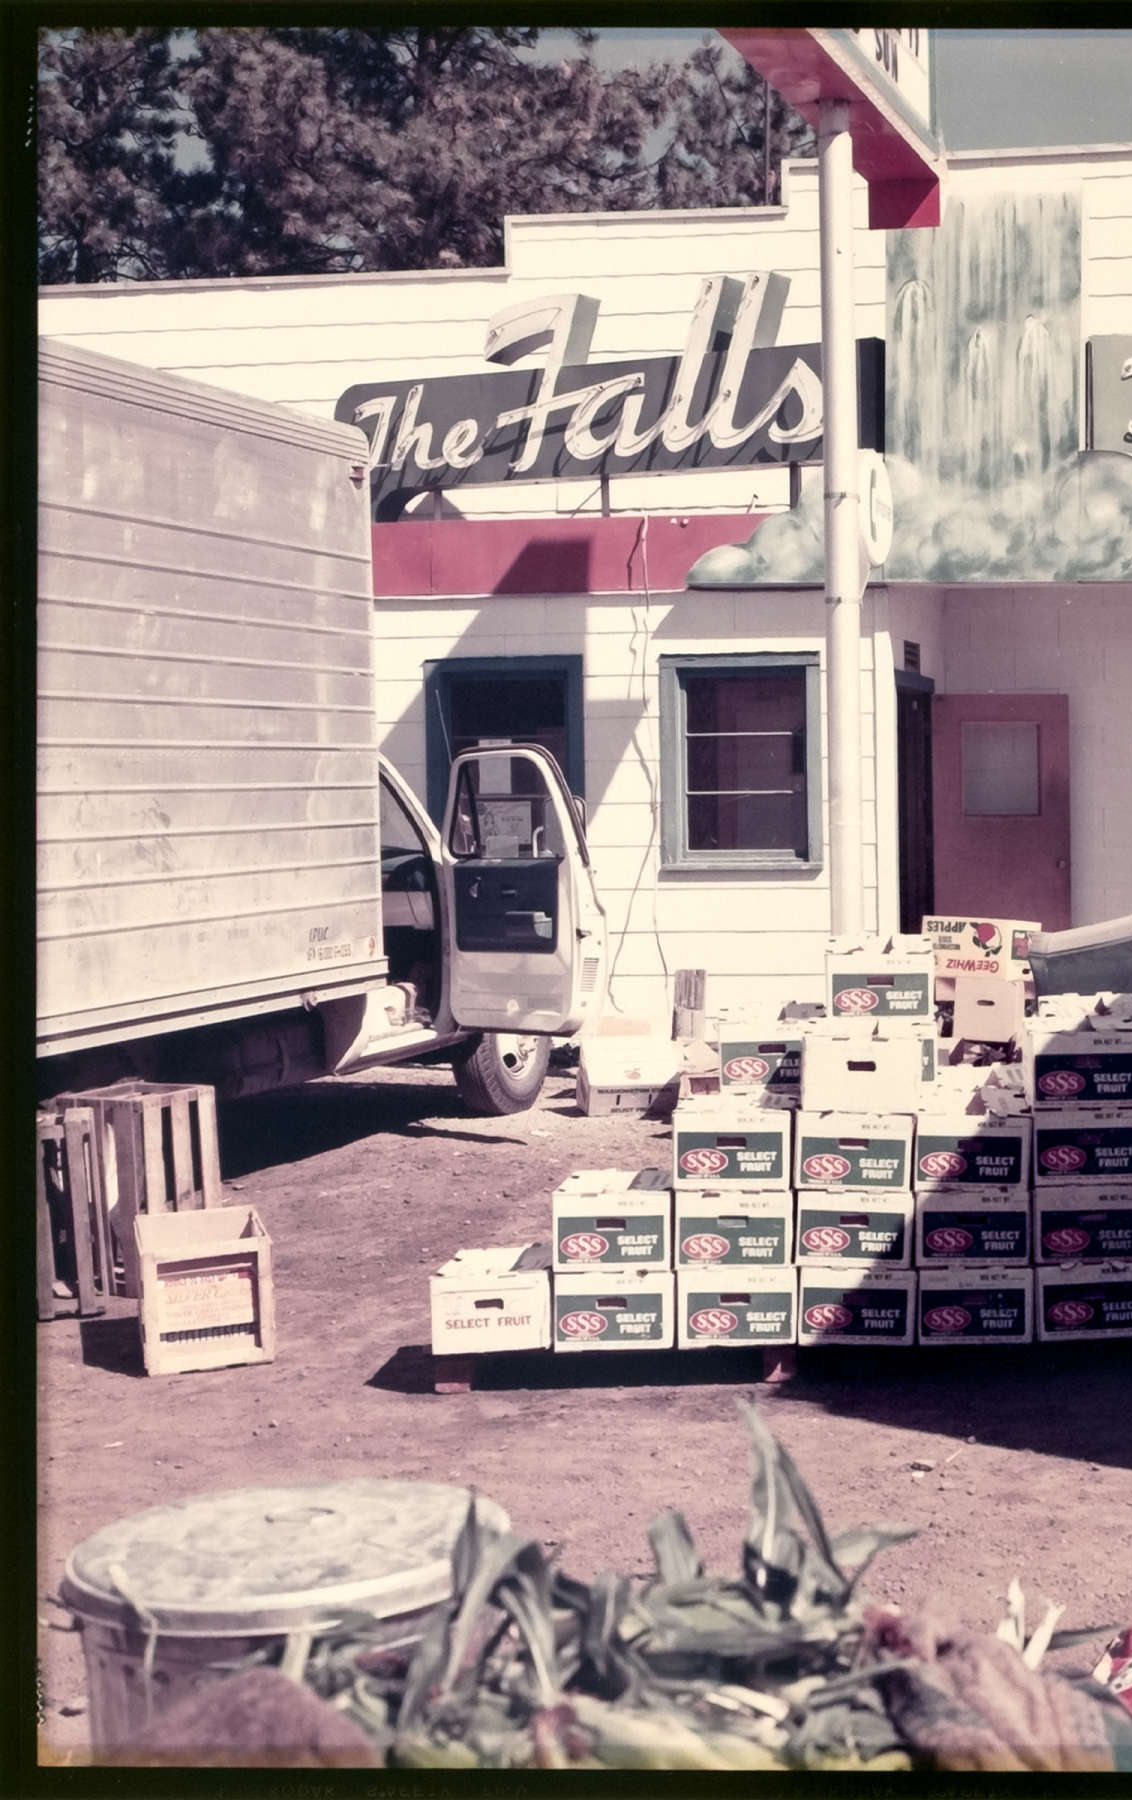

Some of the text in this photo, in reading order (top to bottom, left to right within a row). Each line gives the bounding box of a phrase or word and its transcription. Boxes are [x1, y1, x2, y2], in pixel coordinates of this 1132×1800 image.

[353, 269, 824, 472] The Falls
[926, 920, 967, 933] APPLES
[840, 989, 872, 1011] SSS
[886, 990, 923, 1000] SELECT
[890, 1001, 919, 1010] FRUIT
[730, 1057, 762, 1080] SSS
[1046, 1072, 1078, 1093] SSS
[1093, 1073, 1131, 1083] SELECT
[1097, 1084, 1127, 1093] FRUIT
[736, 1151, 777, 1161] SELECT
[1047, 1146, 1079, 1168] SSS
[1095, 1147, 1132, 1157] SELECT
[689, 1149, 721, 1173] SSS
[811, 1155, 844, 1178] SSS
[859, 1158, 899, 1169] SELECT
[928, 1153, 960, 1175] SSS
[976, 1156, 1015, 1166] SELECT
[1098, 1158, 1129, 1167] FRUIT
[740, 1162, 772, 1172] FRUIT
[979, 1167, 1008, 1176] FRUIT
[862, 1169, 894, 1179] FRUIT
[617, 1235, 658, 1245] SELECT
[810, 1227, 843, 1250] SSS
[859, 1231, 897, 1242] SELECT
[933, 1229, 965, 1251] SSS
[981, 1231, 1020, 1241] SELECT
[1051, 1229, 1083, 1250] SSS
[568, 1234, 601, 1257] SSS
[689, 1235, 722, 1258] SSS
[738, 1237, 779, 1247] SELECT
[861, 1242, 892, 1252] FRUIT
[984, 1241, 1015, 1251] FRUIT
[1102, 1240, 1132, 1249] FRUIT
[621, 1246, 653, 1256] FRUIT
[742, 1247, 774, 1257] FRUIT
[616, 1313, 657, 1323] SELECT
[746, 1311, 787, 1322] SELECT
[812, 1305, 845, 1328] SSS
[861, 1308, 900, 1319] SELECT
[980, 1308, 1018, 1318] SELECT
[1055, 1302, 1087, 1323] SSS
[445, 1315, 532, 1330] SELECT FRUIT
[568, 1312, 600, 1335] SSS
[697, 1310, 730, 1333] SSS
[864, 1319, 895, 1329] FRUIT
[931, 1308, 964, 1329] SSS
[983, 1319, 1014, 1328] FRUIT
[620, 1323, 652, 1334] FRUIT
[750, 1322, 781, 1333] FRUIT
